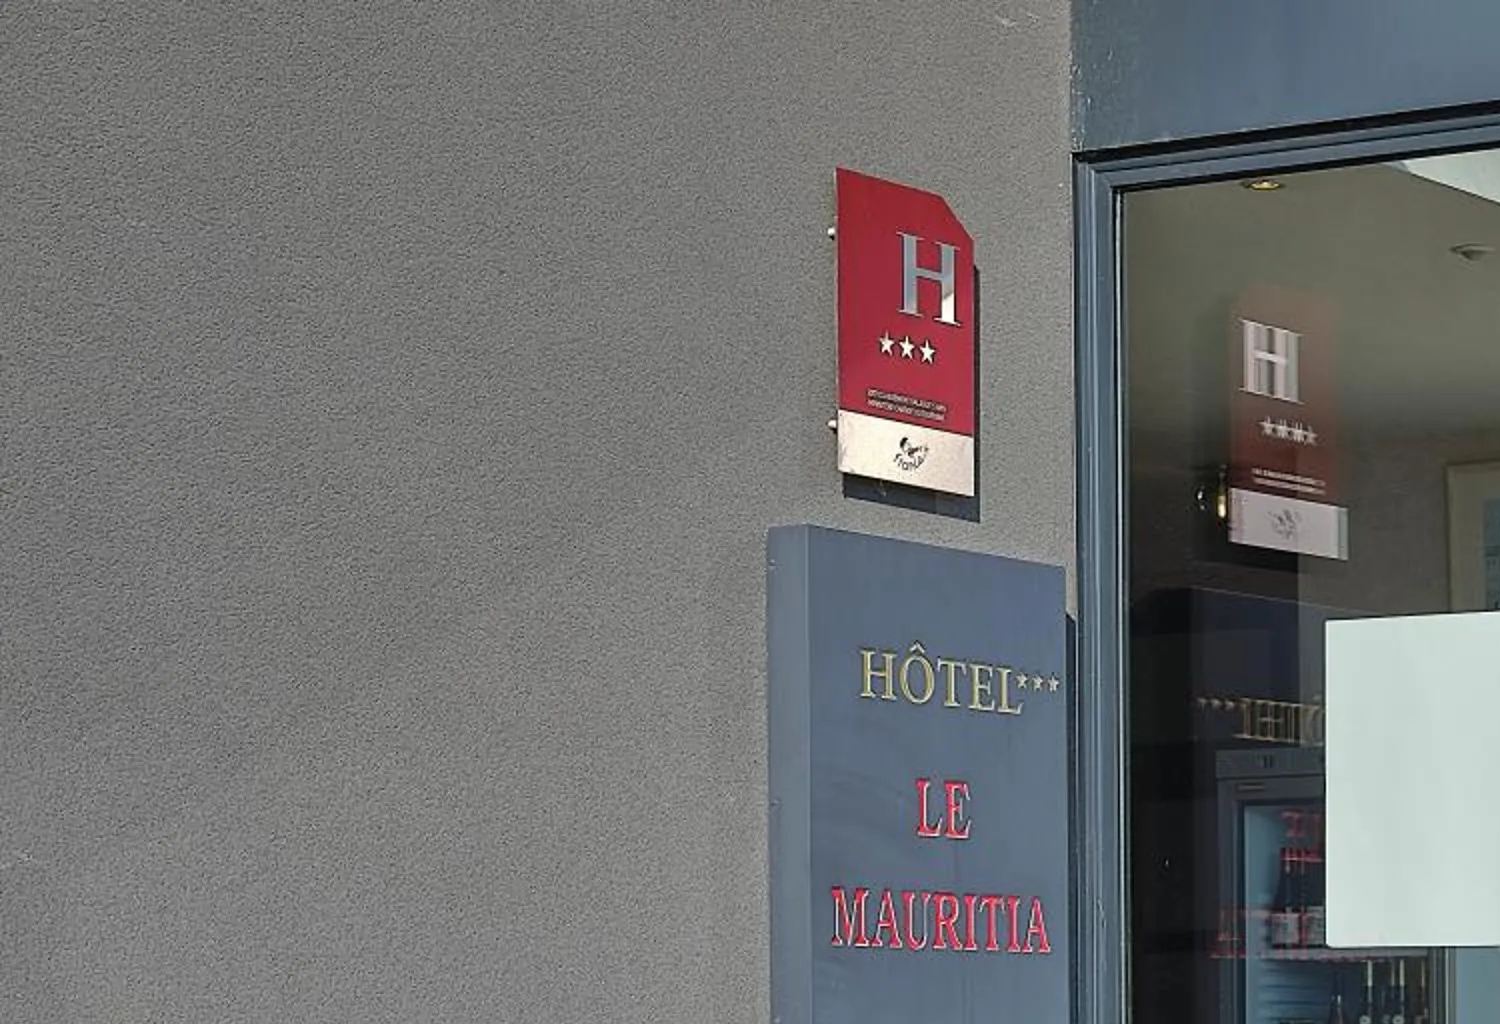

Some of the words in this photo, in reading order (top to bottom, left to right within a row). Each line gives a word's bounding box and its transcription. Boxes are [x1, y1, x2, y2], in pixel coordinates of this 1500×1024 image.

[896, 230, 961, 327] H
[859, 640, 1024, 714] HÔTEL
[915, 778, 972, 839] LE
[831, 885, 1051, 953] MAURITIA
